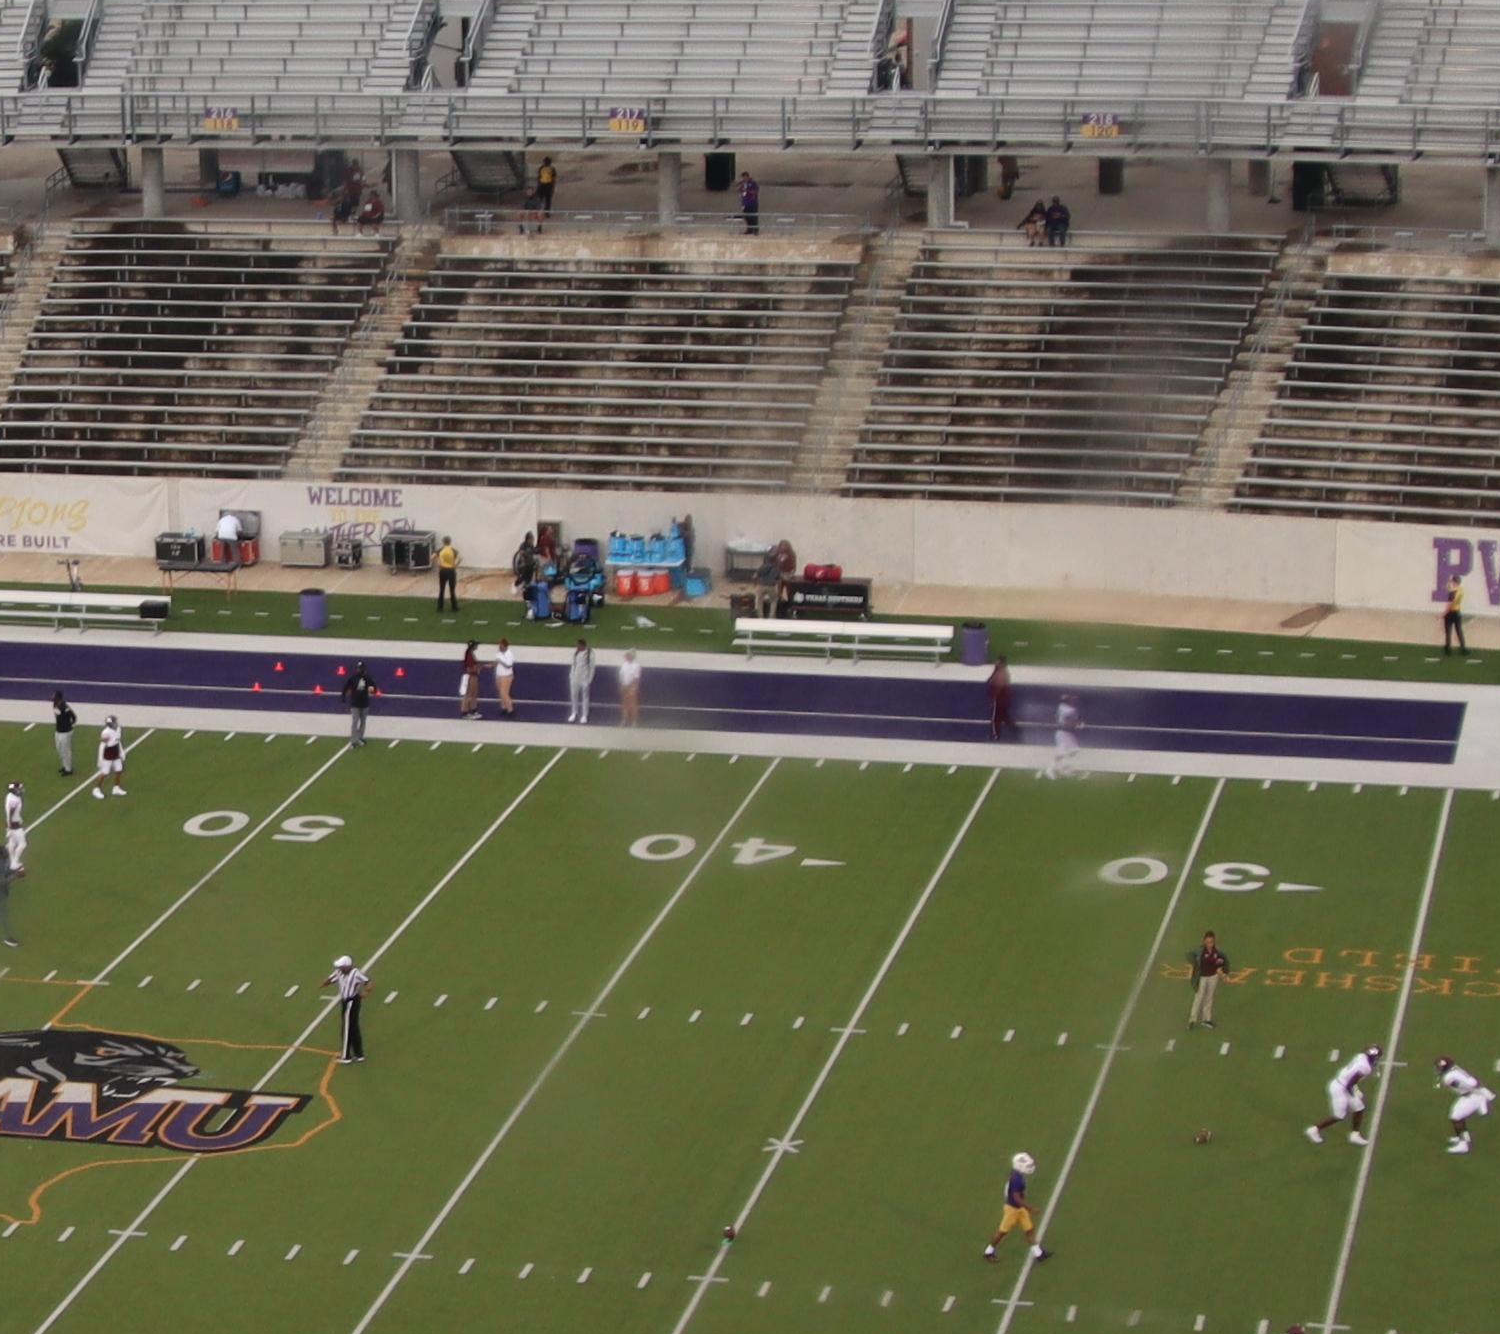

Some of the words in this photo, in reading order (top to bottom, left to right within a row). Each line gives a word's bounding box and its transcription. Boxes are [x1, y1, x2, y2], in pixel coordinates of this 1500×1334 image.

[617, 107, 640, 118] 217
[1089, 113, 1113, 124] 218
[307, 486, 403, 508] WELCOME
[21, 535, 71, 550] BUILT
[182, 810, 346, 843] 50
[628, 833, 797, 867] 40
[1100, 856, 1272, 892] 30
